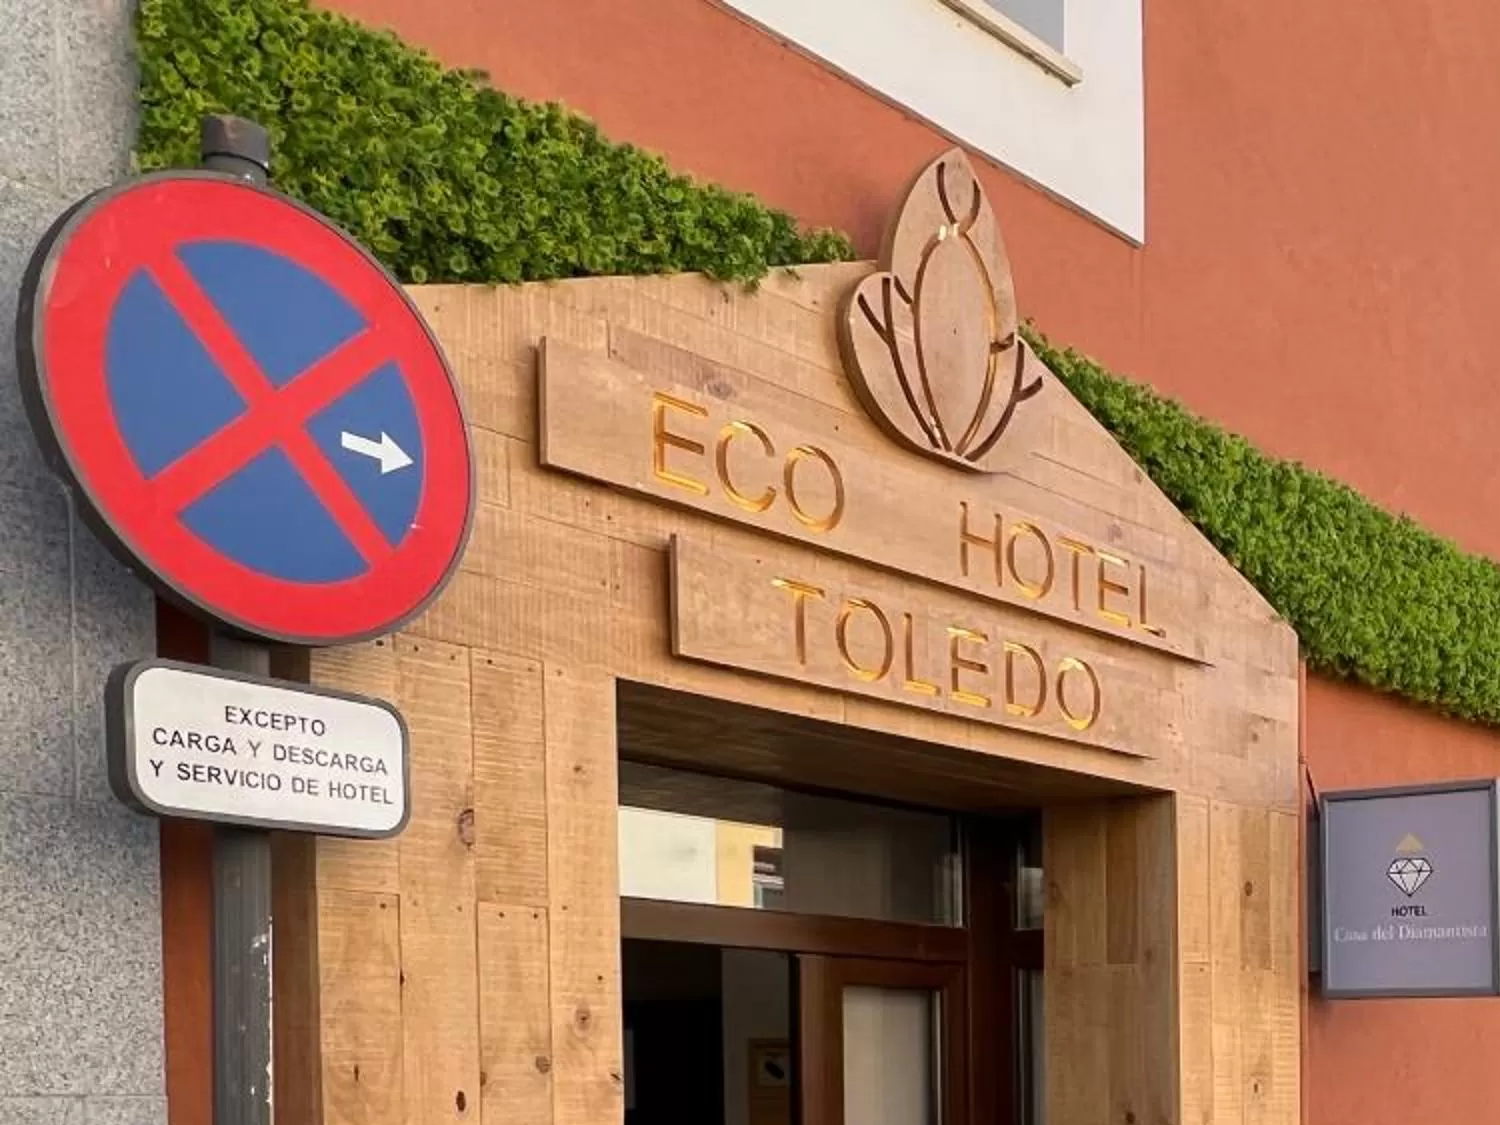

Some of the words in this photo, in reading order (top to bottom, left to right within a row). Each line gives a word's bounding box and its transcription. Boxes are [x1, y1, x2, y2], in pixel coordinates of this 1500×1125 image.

[653, 391, 845, 533] ECO
[959, 500, 1166, 639] HOTEL
[772, 577, 1102, 731] TOLEDO
[225, 705, 326, 737] EXCEPTO
[152, 728, 237, 756] CARGA
[248, 740, 262, 758] Y
[273, 744, 388, 775] DESCARGA
[150, 759, 165, 778] Y
[177, 763, 282, 791] SERVICIO
[291, 777, 319, 796] DE
[328, 782, 393, 805] HOTEL
[1391, 905, 1427, 917] HOTEL
